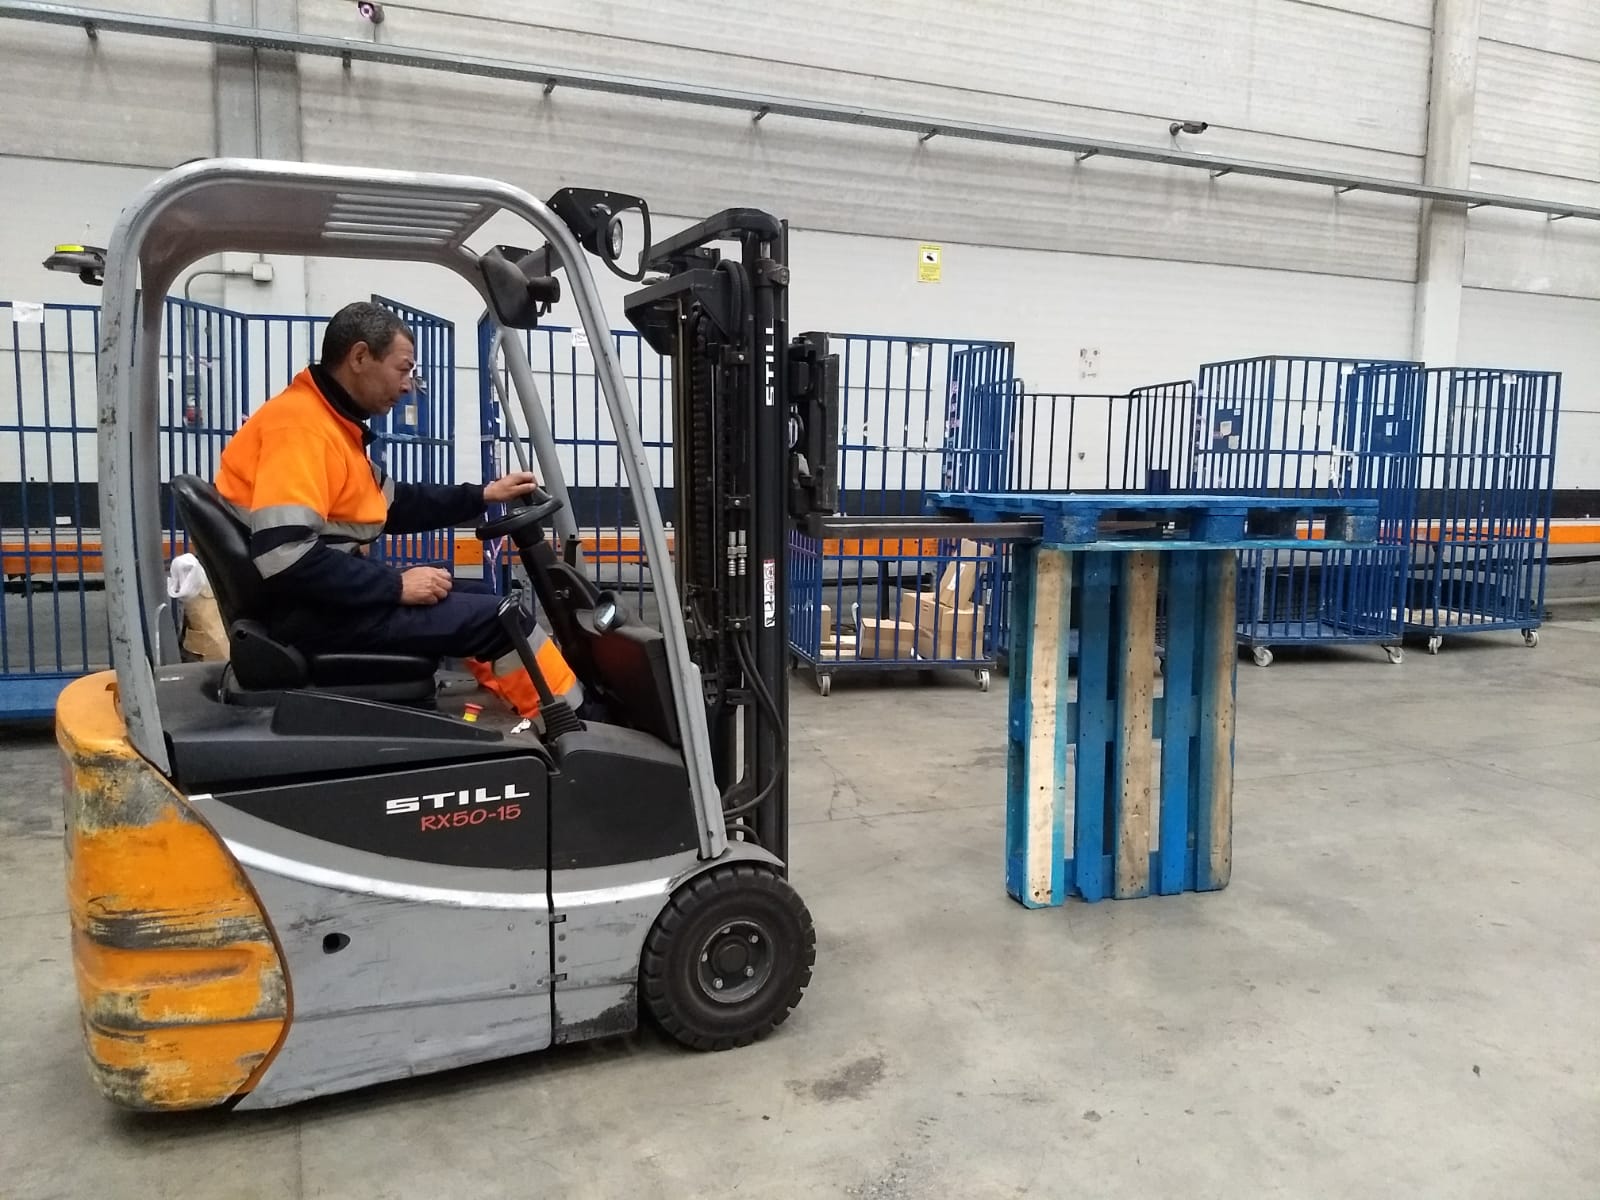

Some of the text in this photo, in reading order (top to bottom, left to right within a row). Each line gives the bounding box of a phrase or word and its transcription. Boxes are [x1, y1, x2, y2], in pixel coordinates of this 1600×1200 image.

[765, 318, 774, 406] STILL
[386, 784, 530, 815] STILL
[420, 803, 522, 832] RX50-15
